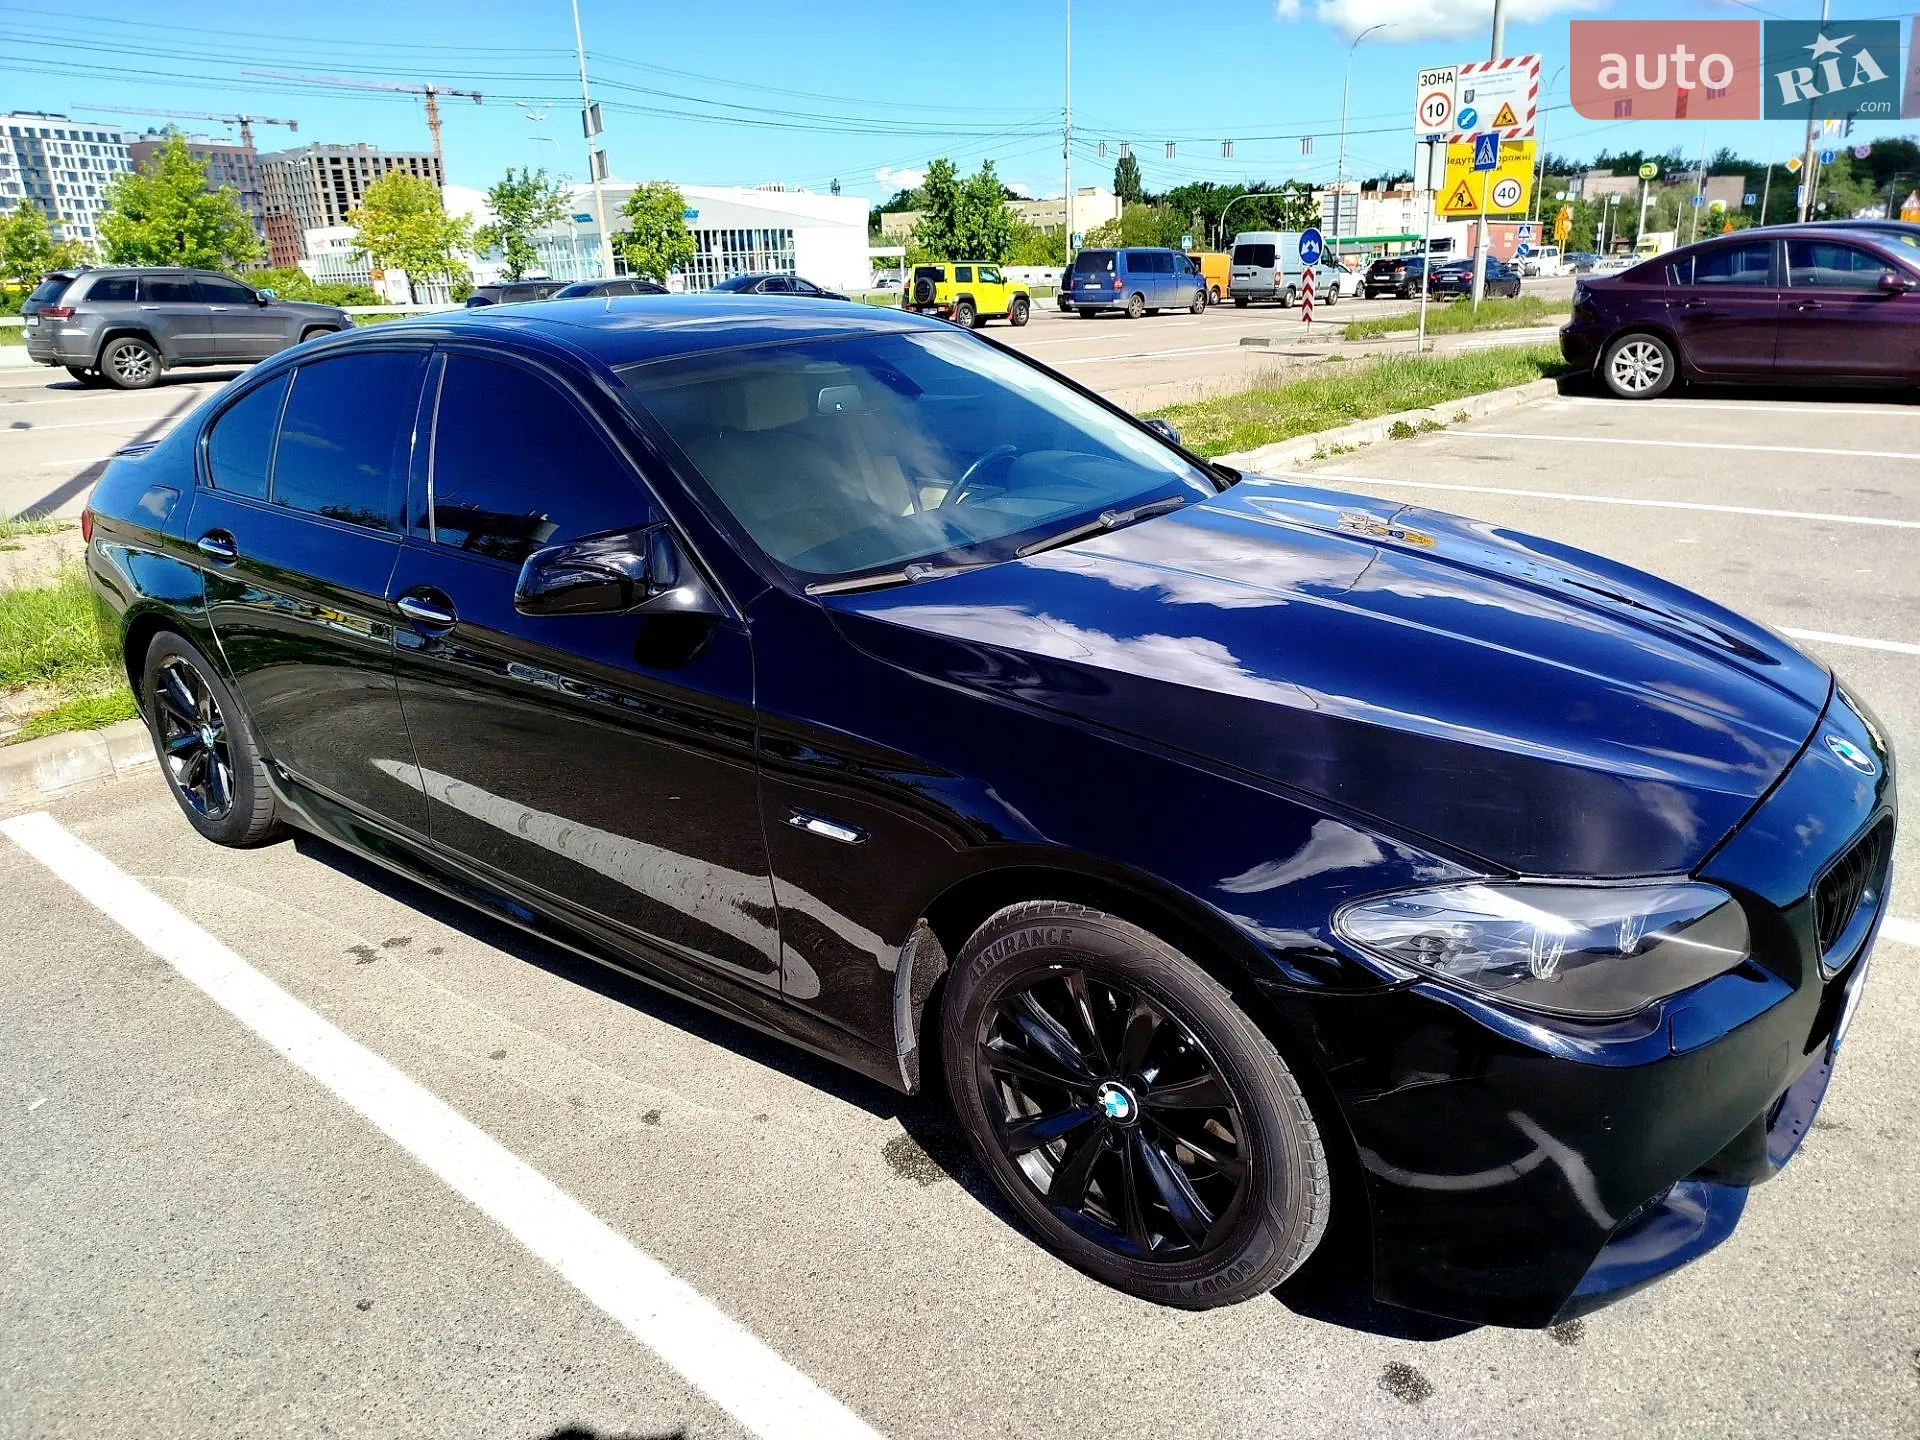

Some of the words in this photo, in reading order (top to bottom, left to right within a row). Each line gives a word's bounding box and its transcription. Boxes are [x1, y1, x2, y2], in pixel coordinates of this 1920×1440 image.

[1420, 71, 1454, 87] ЗОНА
[1426, 102, 1444, 118] 10
[1497, 187, 1516, 199] 40
[968, 927, 1073, 986] ASSURANCE
